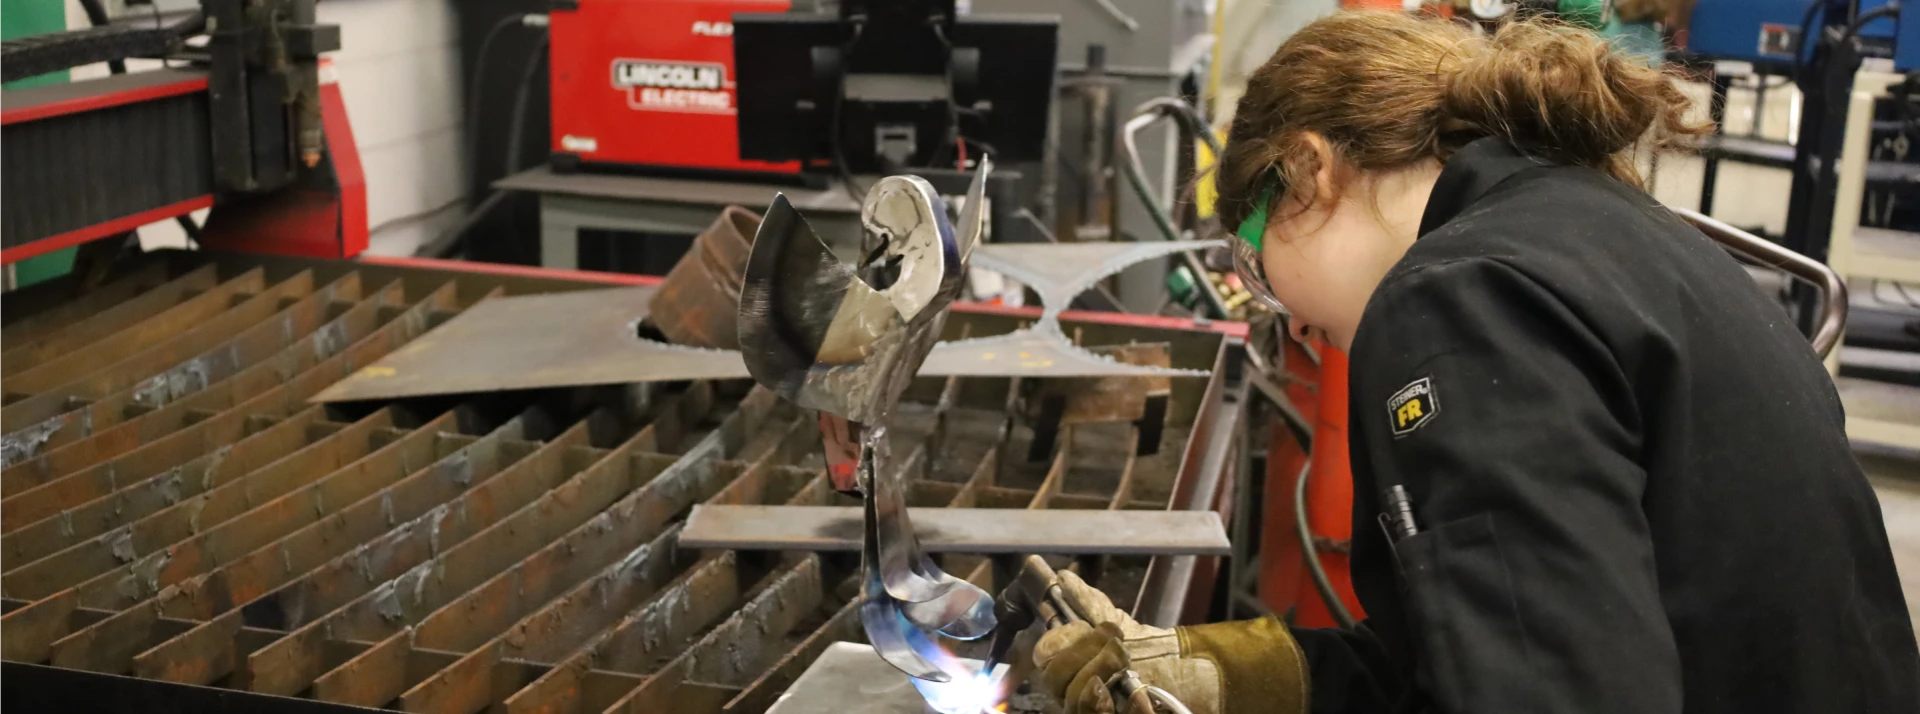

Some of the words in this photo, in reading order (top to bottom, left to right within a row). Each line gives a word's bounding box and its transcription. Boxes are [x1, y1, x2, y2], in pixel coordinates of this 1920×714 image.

[619, 63, 719, 89] LINCOLN
[641, 88, 730, 108] ELECTRIC
[1397, 398, 1423, 427] FR
